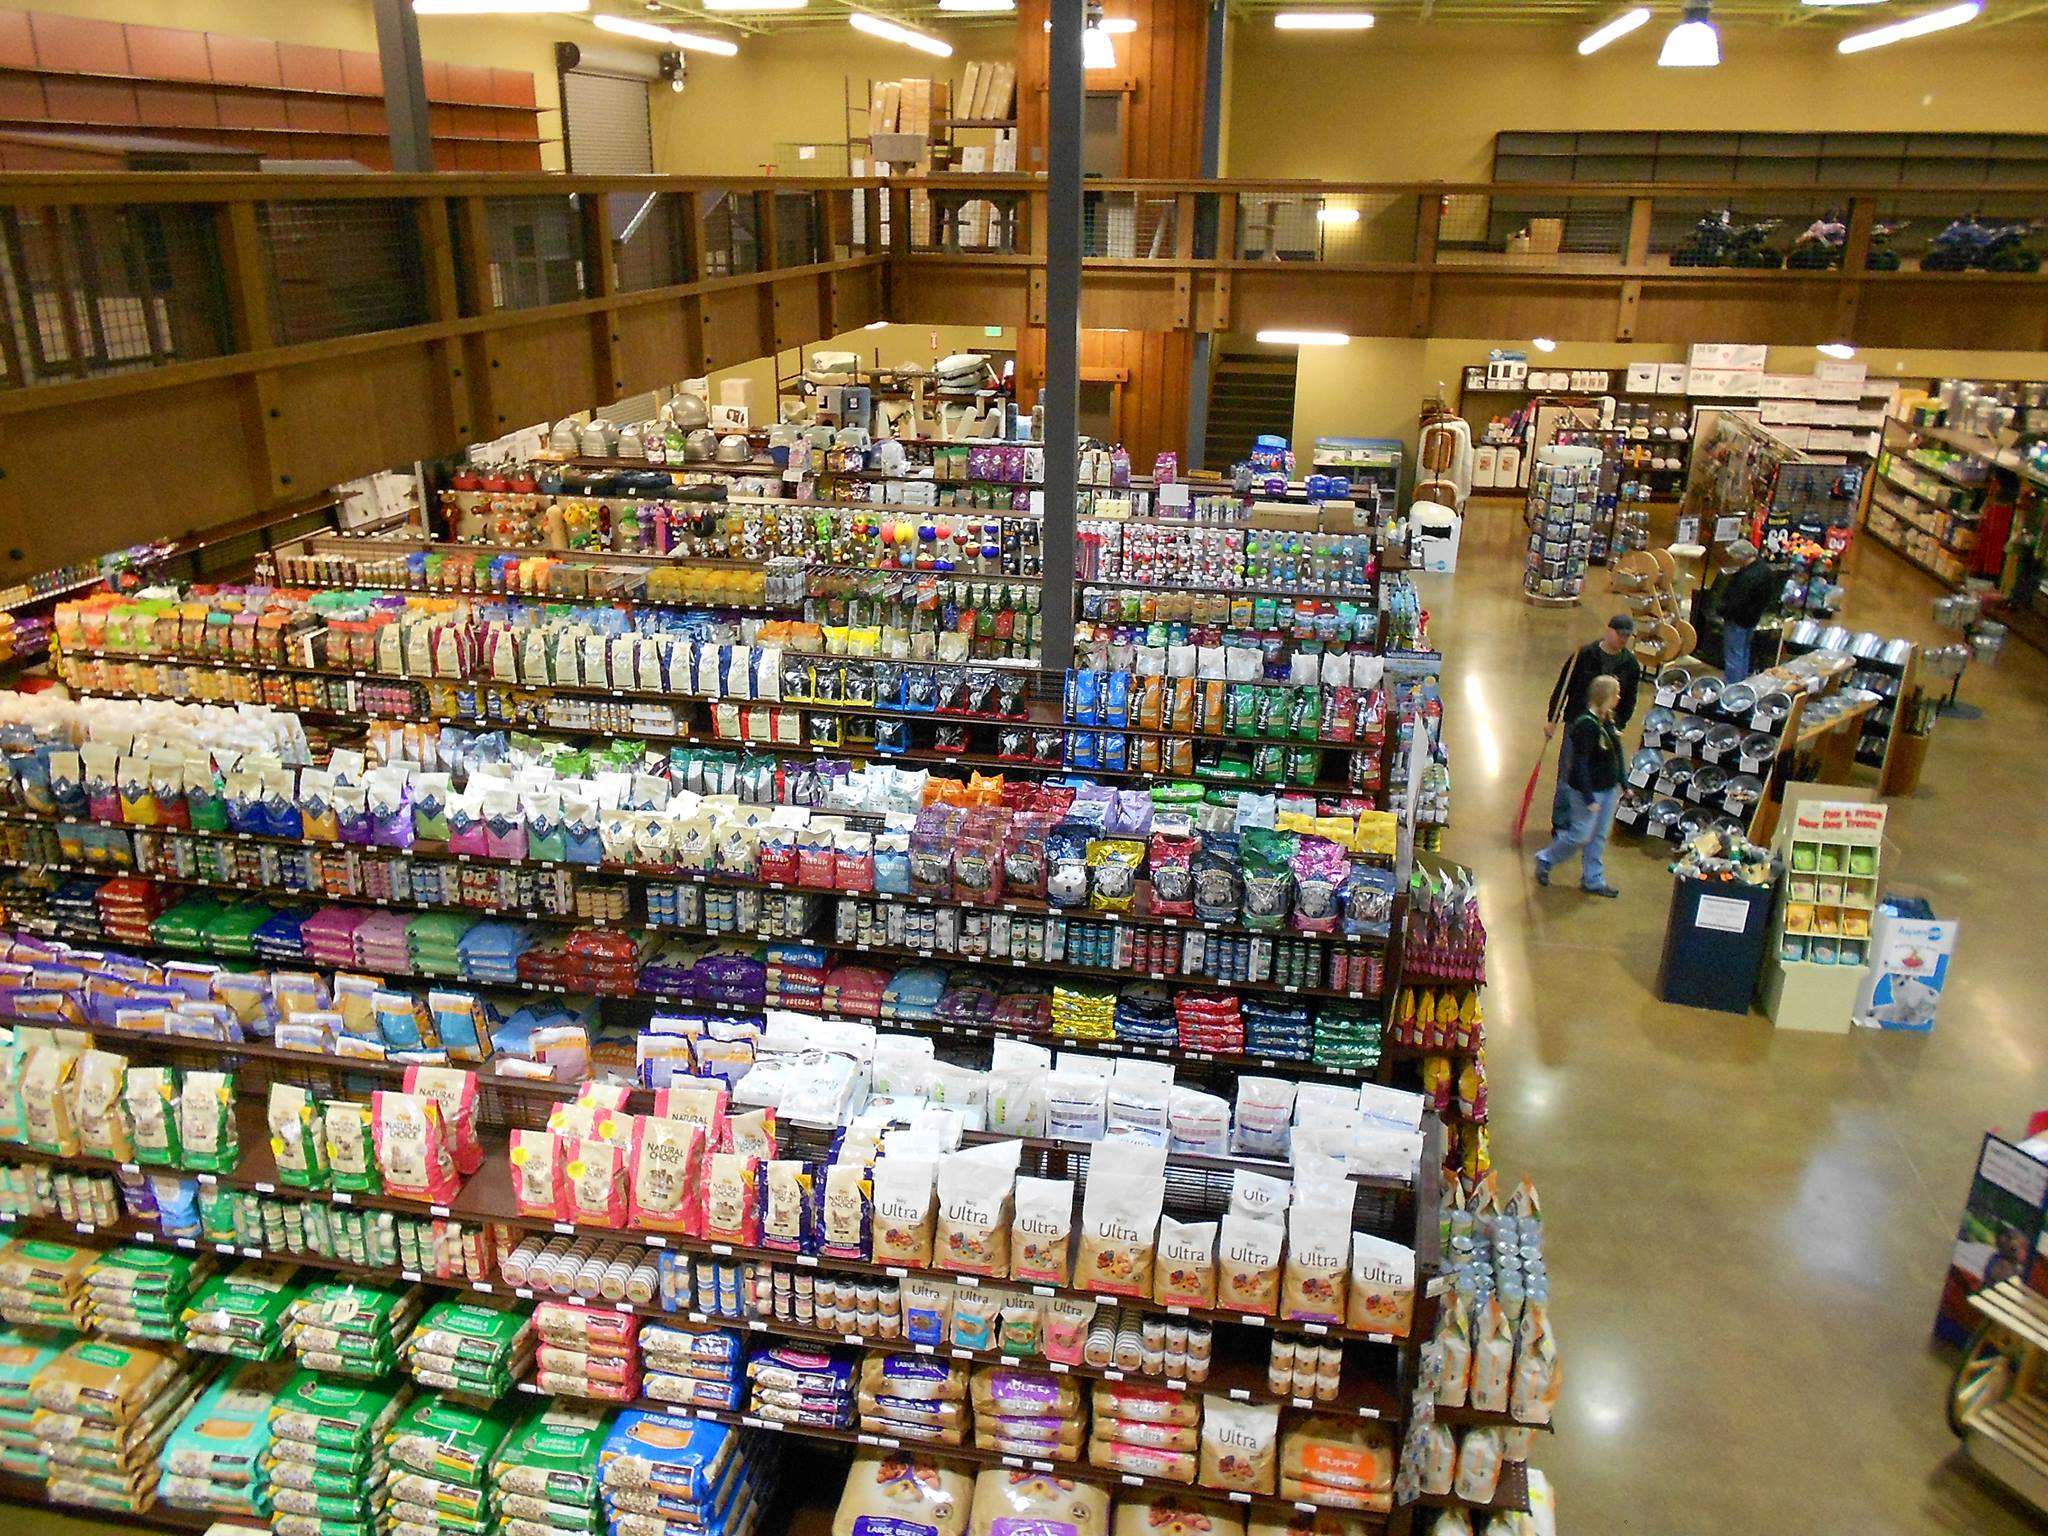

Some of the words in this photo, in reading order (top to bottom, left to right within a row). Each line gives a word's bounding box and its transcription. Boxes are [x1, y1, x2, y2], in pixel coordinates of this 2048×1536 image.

[671, 1113, 707, 1124] NATURAL
[647, 1141, 684, 1158] NATURAL
[649, 1151, 680, 1165] CHOICE
[881, 1203, 919, 1221] Ultra
[949, 1204, 988, 1225] Ultra
[1021, 1218, 1059, 1236] Ultra
[1099, 1222, 1138, 1242] Ultra
[1167, 1244, 1205, 1262] Ultra
[1230, 1247, 1269, 1266] Ultra
[1299, 1252, 1339, 1268] Ultra
[1363, 1266, 1402, 1285] Ultra
[911, 1284, 940, 1300] Ultra
[959, 1289, 989, 1306] Ultra
[1005, 1297, 1035, 1311] Ultra
[1053, 1300, 1083, 1317] Ultra
[1219, 1427, 1257, 1450] Ultra
